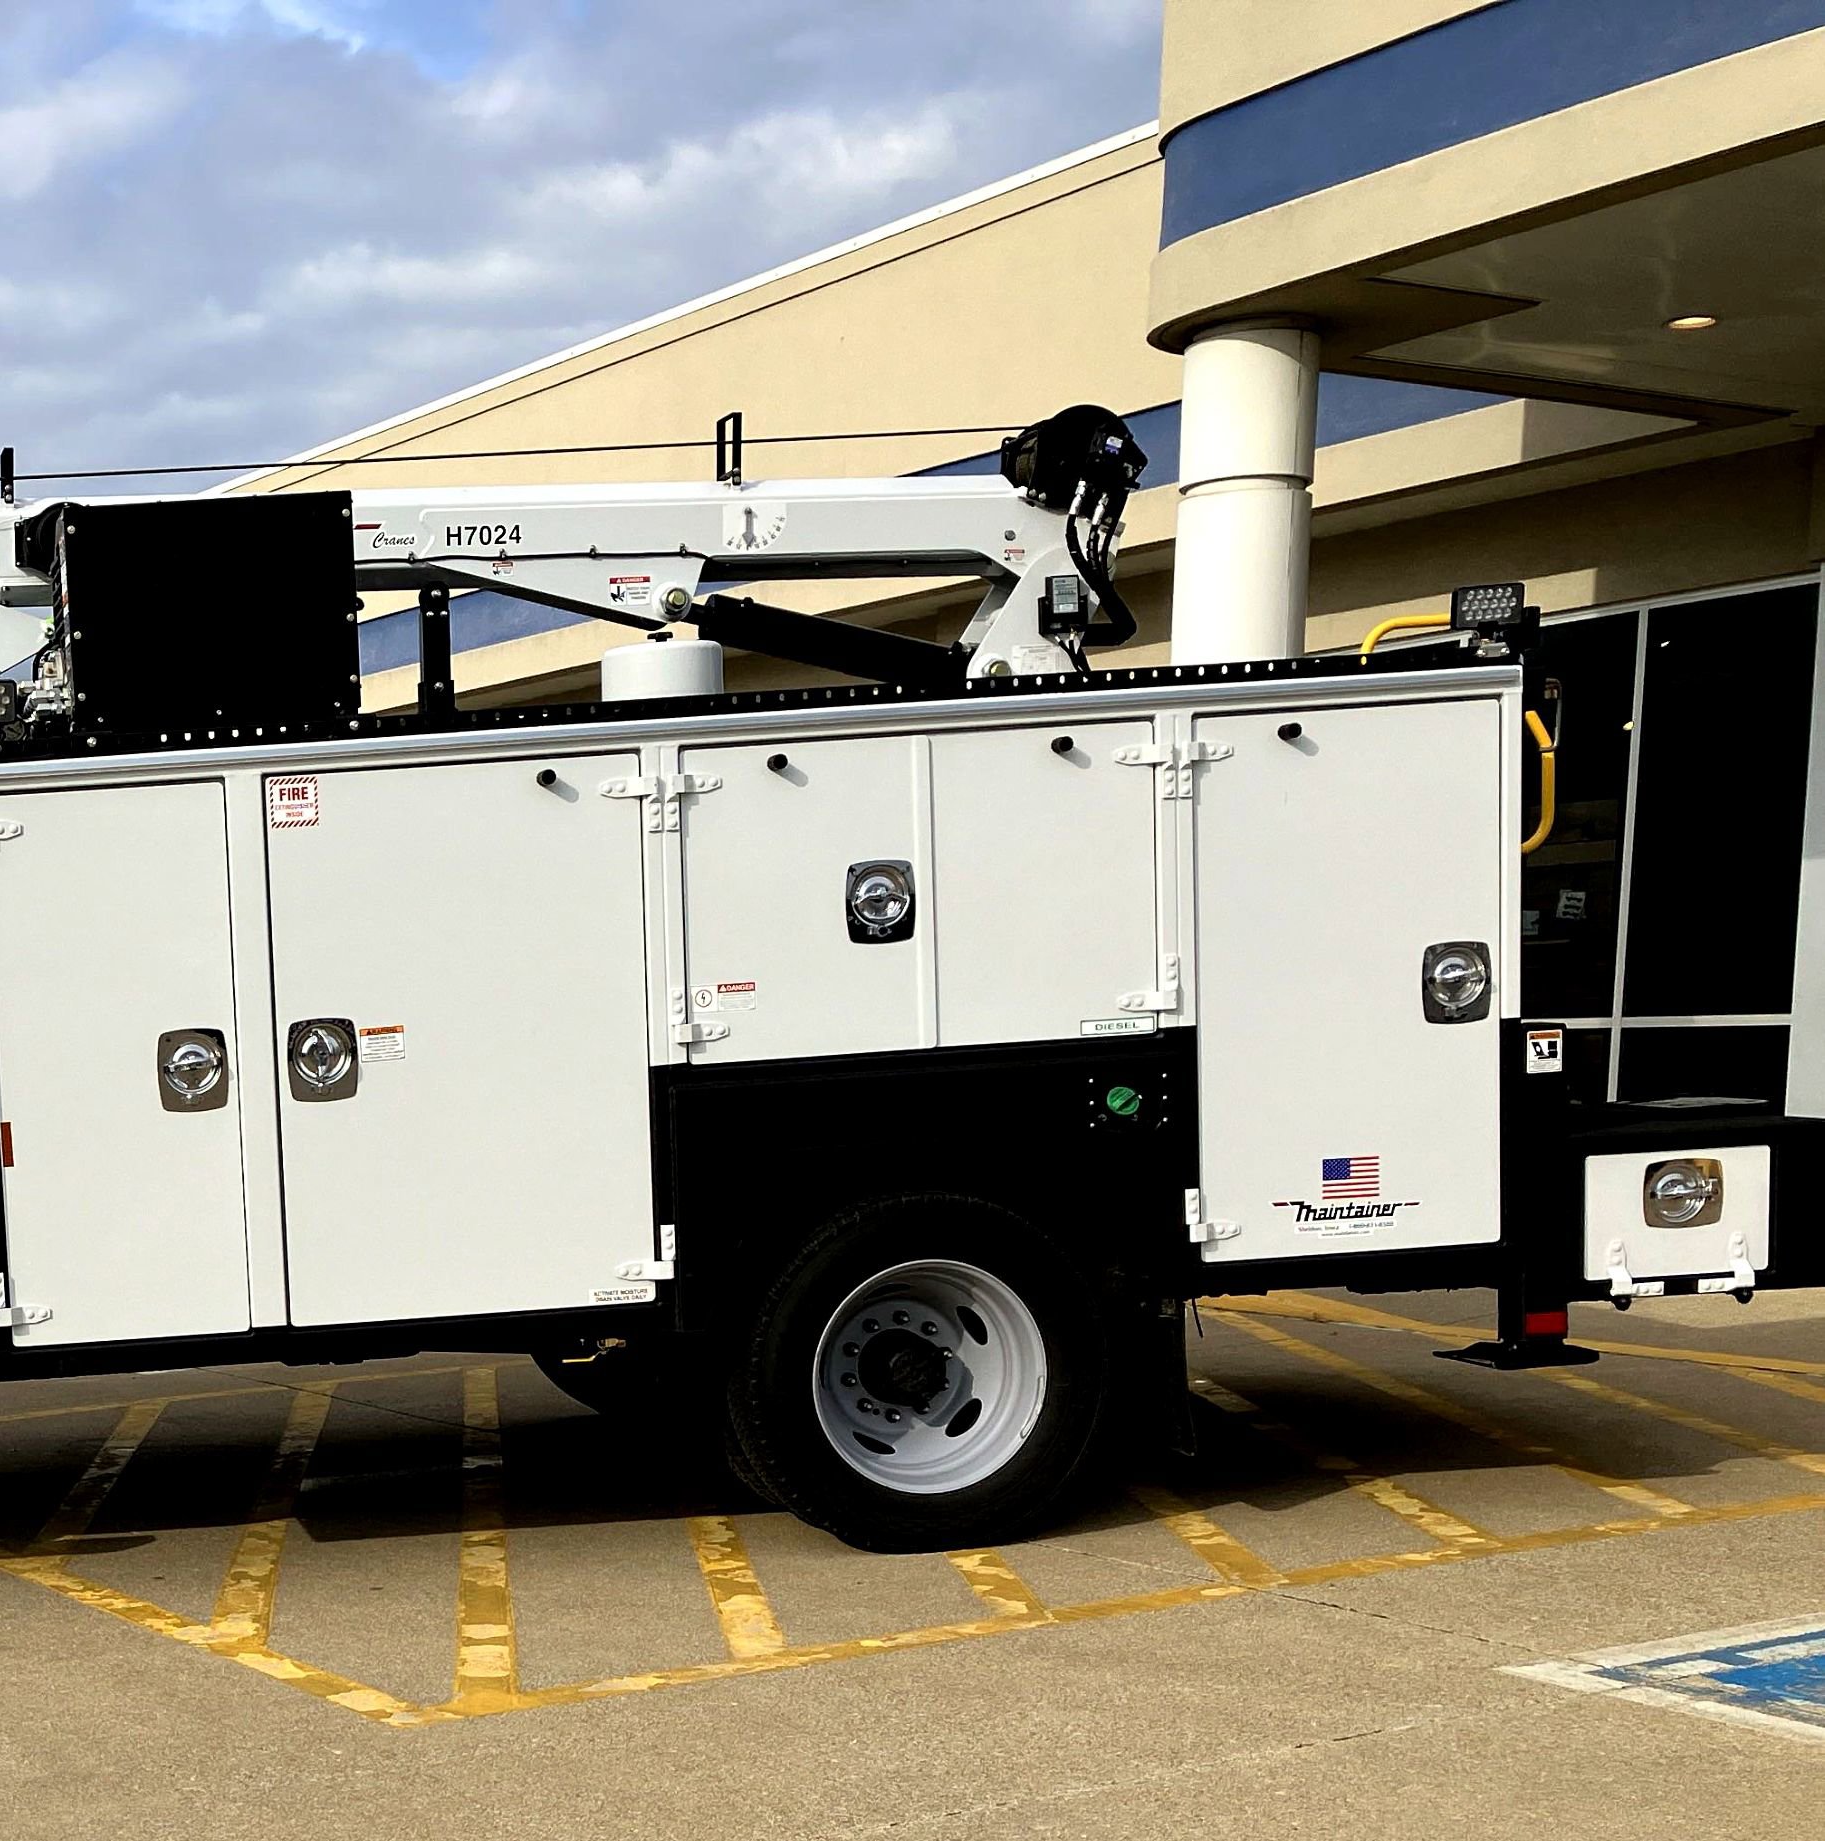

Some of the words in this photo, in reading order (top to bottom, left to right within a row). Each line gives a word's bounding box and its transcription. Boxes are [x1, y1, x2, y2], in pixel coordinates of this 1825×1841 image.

[373, 531, 415, 548] Cranes
[446, 524, 522, 546] H7024
[279, 786, 309, 801] FIRE
[726, 983, 754, 992] DANGER
[1095, 1021, 1140, 1031] DIESEL
[1289, 1201, 1403, 1222] Maintainer
